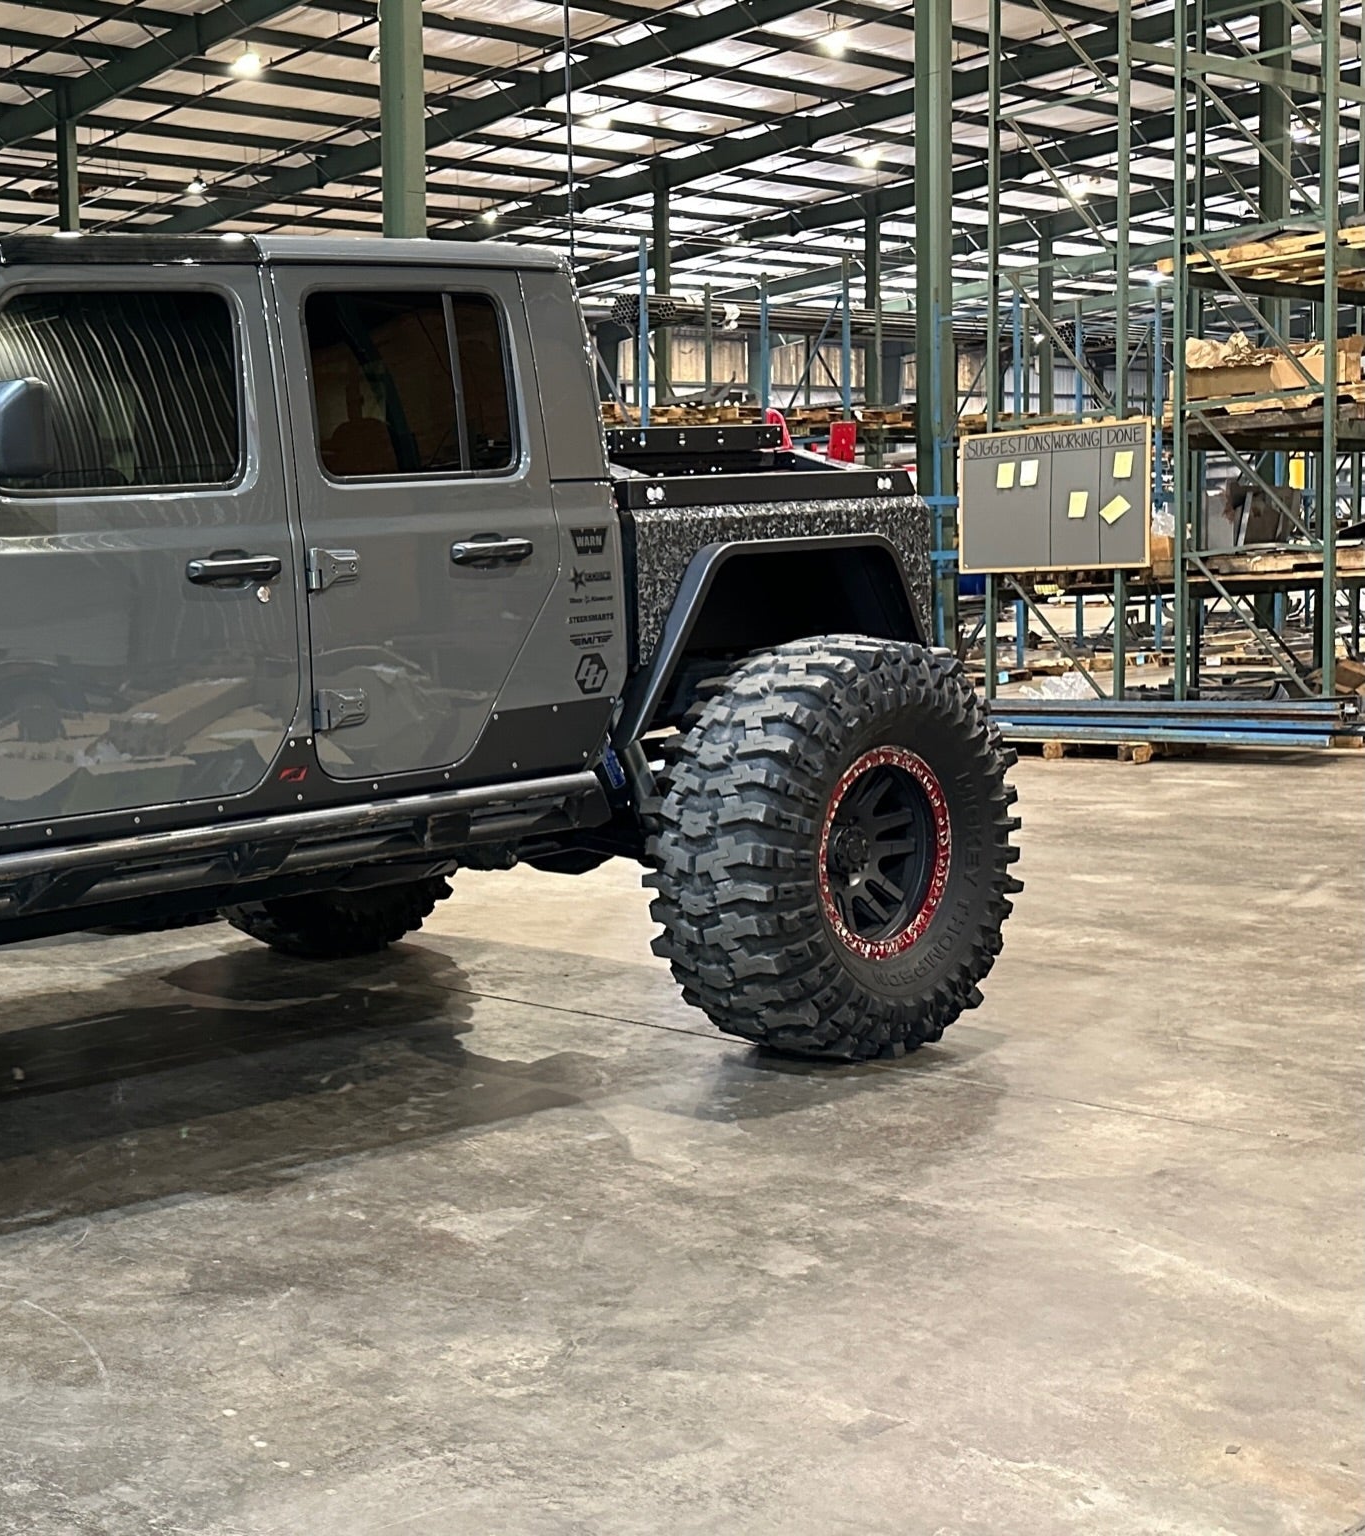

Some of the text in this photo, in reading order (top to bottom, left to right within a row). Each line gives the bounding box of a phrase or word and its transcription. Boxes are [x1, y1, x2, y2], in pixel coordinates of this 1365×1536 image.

[966, 426, 1143, 458] SUGGESTIONS WORKING DONE
[575, 535, 603, 547] WARN
